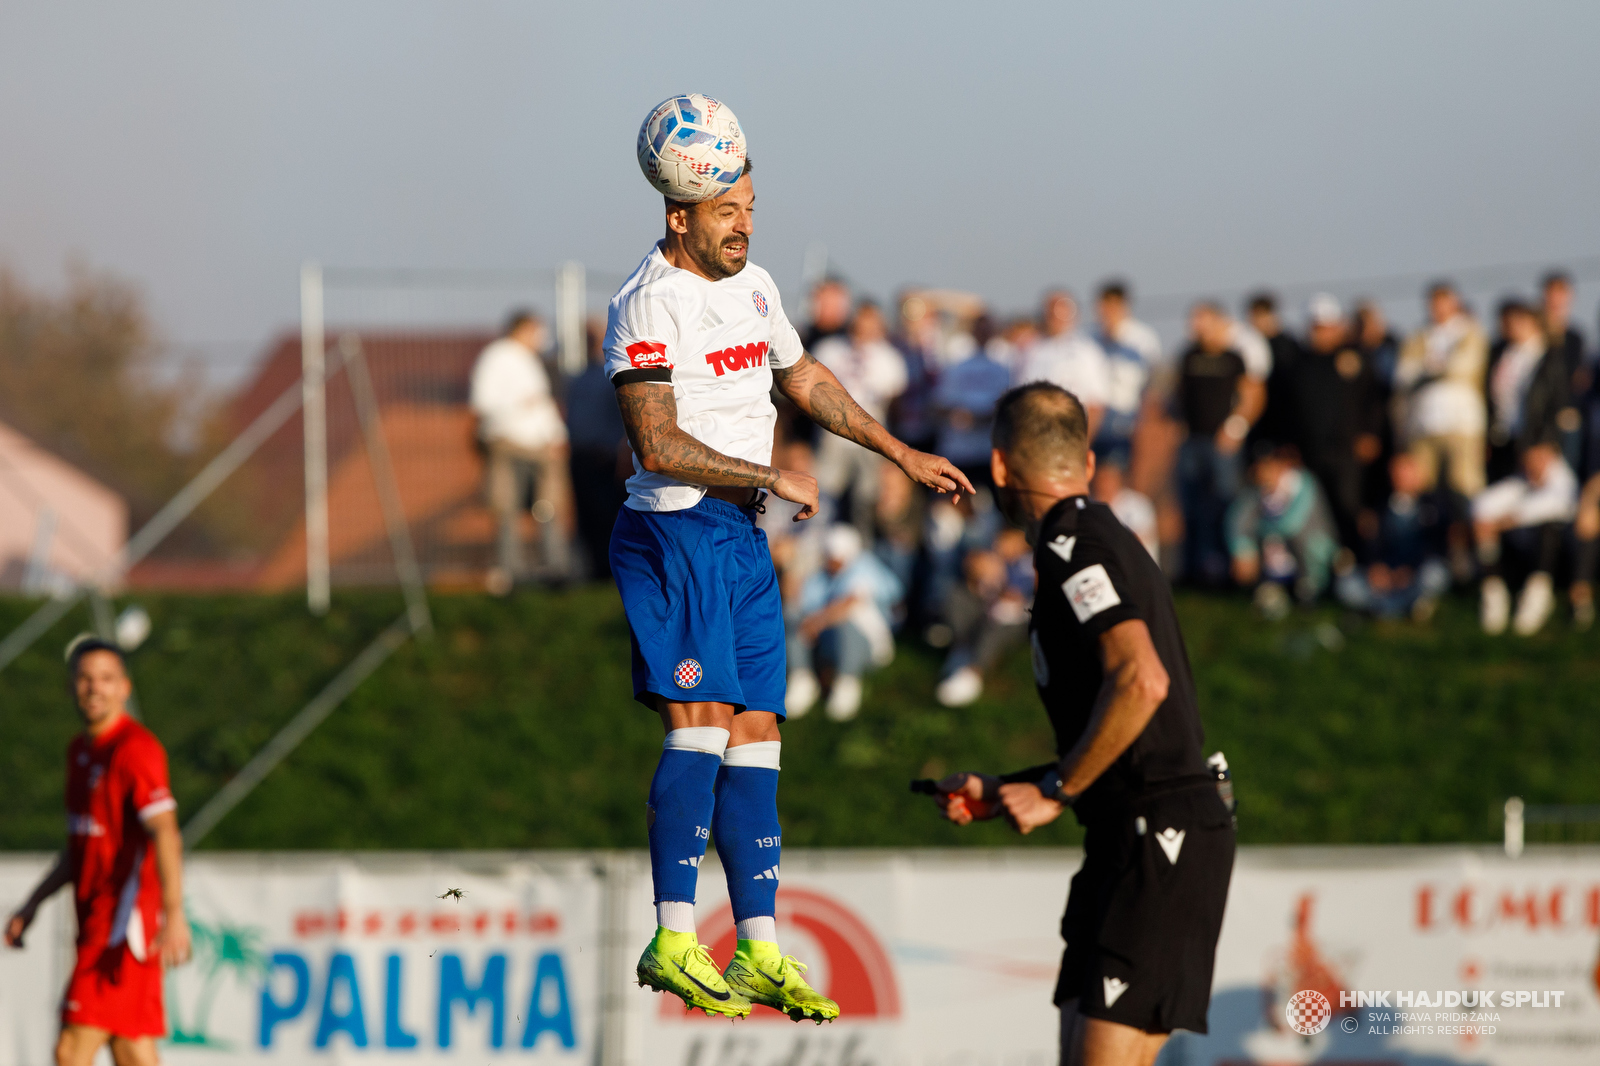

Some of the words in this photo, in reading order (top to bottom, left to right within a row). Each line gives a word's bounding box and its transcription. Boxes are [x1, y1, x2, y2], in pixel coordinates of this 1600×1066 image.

[705, 341, 770, 377] TOMMY
[678, 660, 700, 669] HAJDUK
[678, 679, 696, 687] SPLIT
[258, 952, 577, 1049] PALMA
